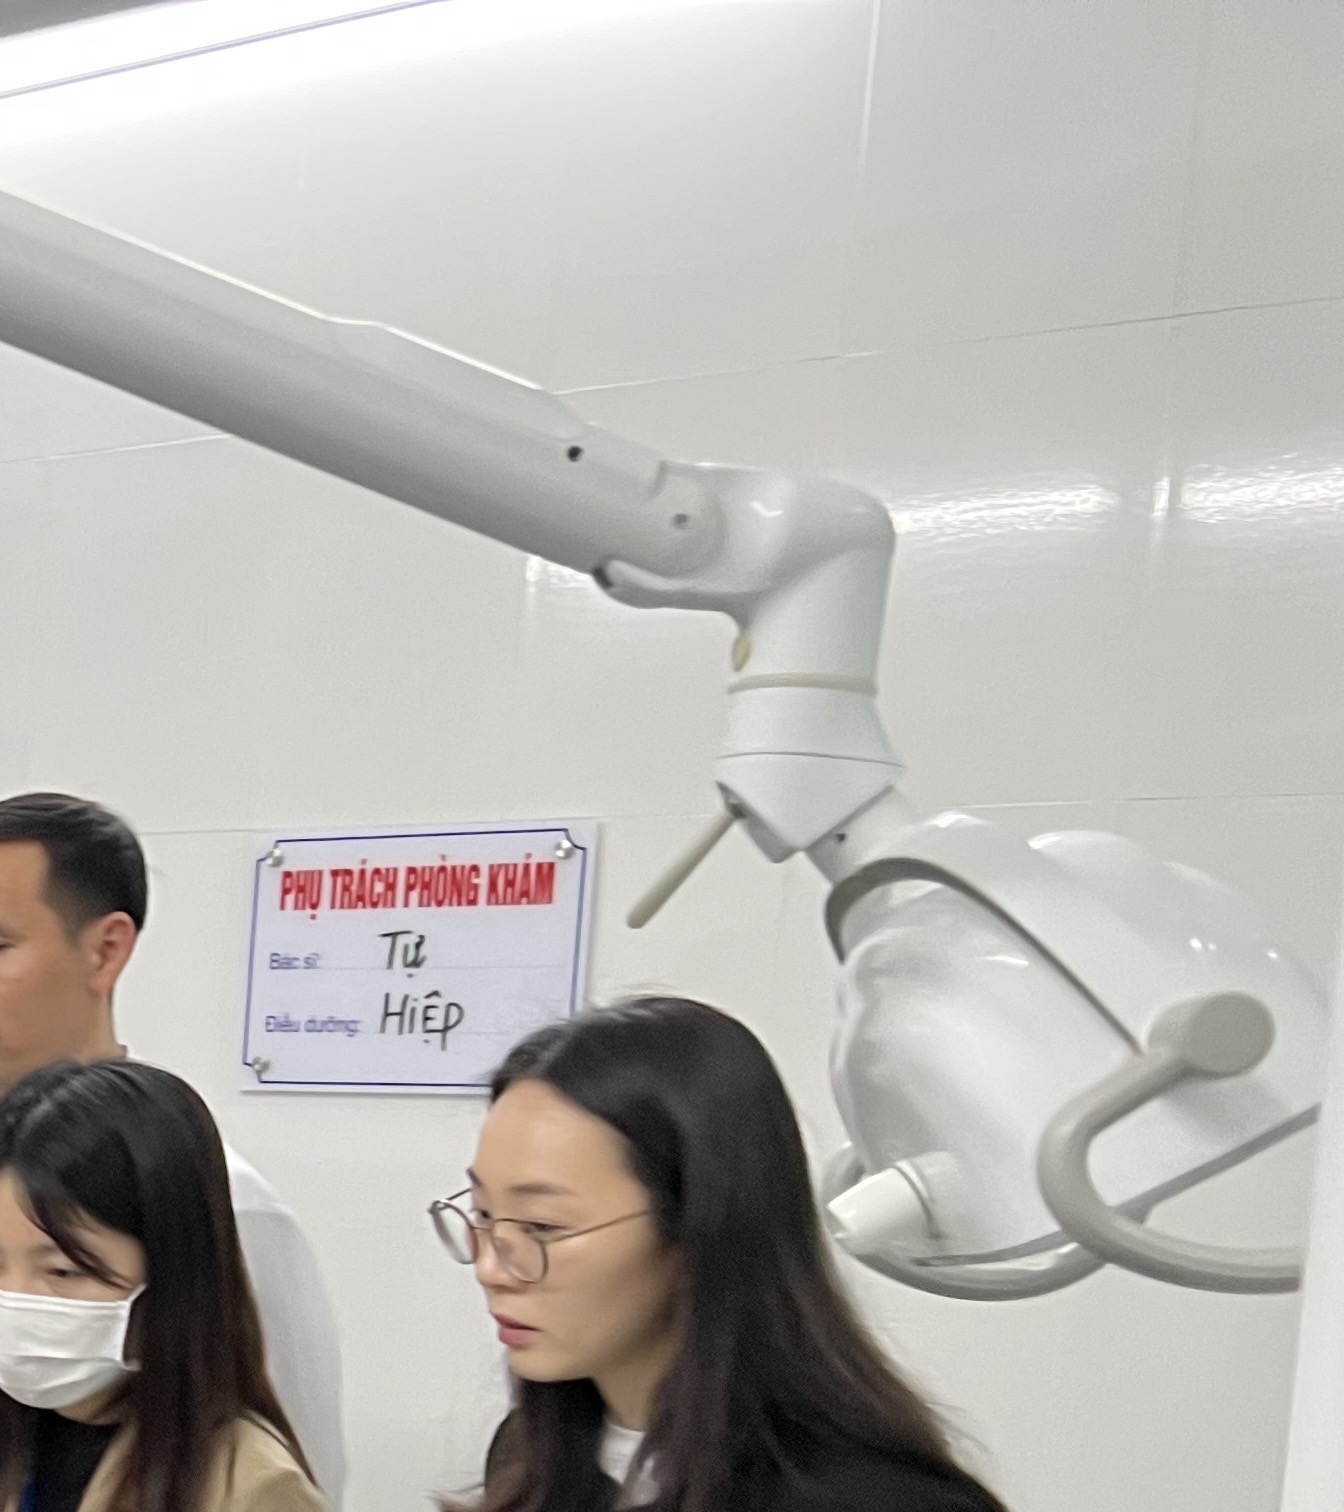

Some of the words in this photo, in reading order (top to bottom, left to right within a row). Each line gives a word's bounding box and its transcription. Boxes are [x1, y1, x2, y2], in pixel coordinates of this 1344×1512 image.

[279, 870, 324, 920] PHỤ
[329, 858, 398, 910] TRÁCH
[403, 855, 480, 908] PHÒNG
[487, 853, 556, 906] KHÁM
